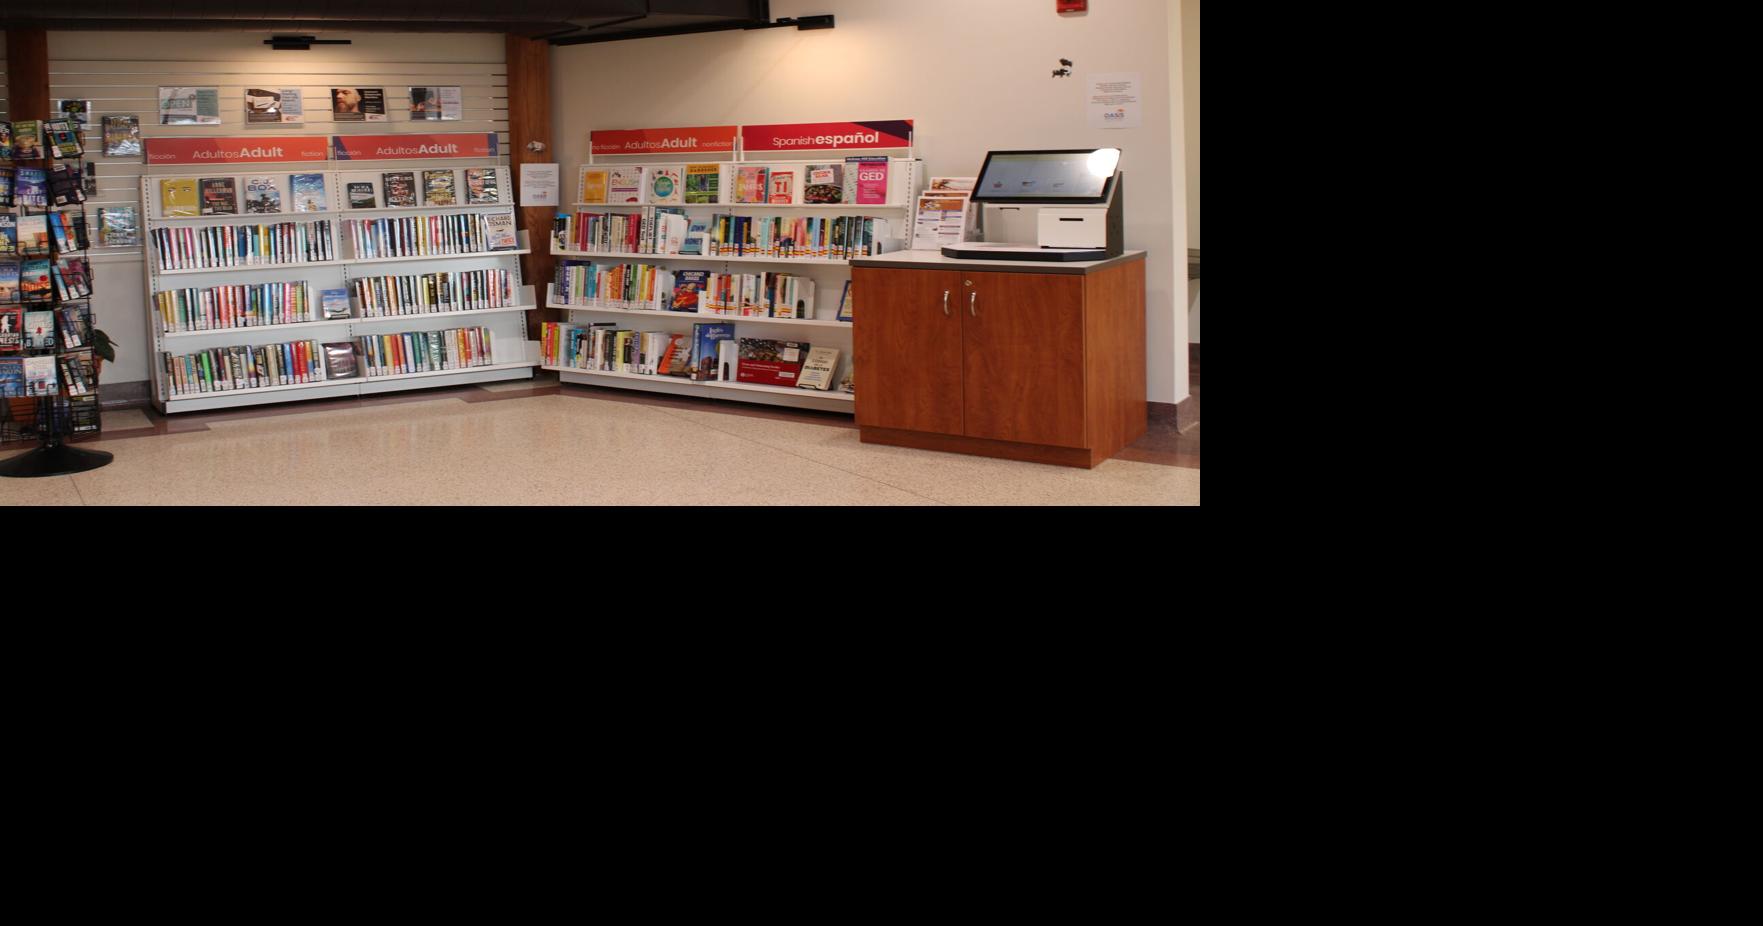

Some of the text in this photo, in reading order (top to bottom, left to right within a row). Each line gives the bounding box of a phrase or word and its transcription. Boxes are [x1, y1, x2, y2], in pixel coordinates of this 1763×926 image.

[624, 141, 661, 150] Adultos
[661, 137, 698, 148] Adult
[772, 131, 879, 148] Spanish español
[192, 150, 239, 159] Adultos
[240, 147, 284, 158] Adult
[376, 147, 418, 155] Adultos
[418, 143, 458, 154] Adult
[859, 171, 884, 181] GED
